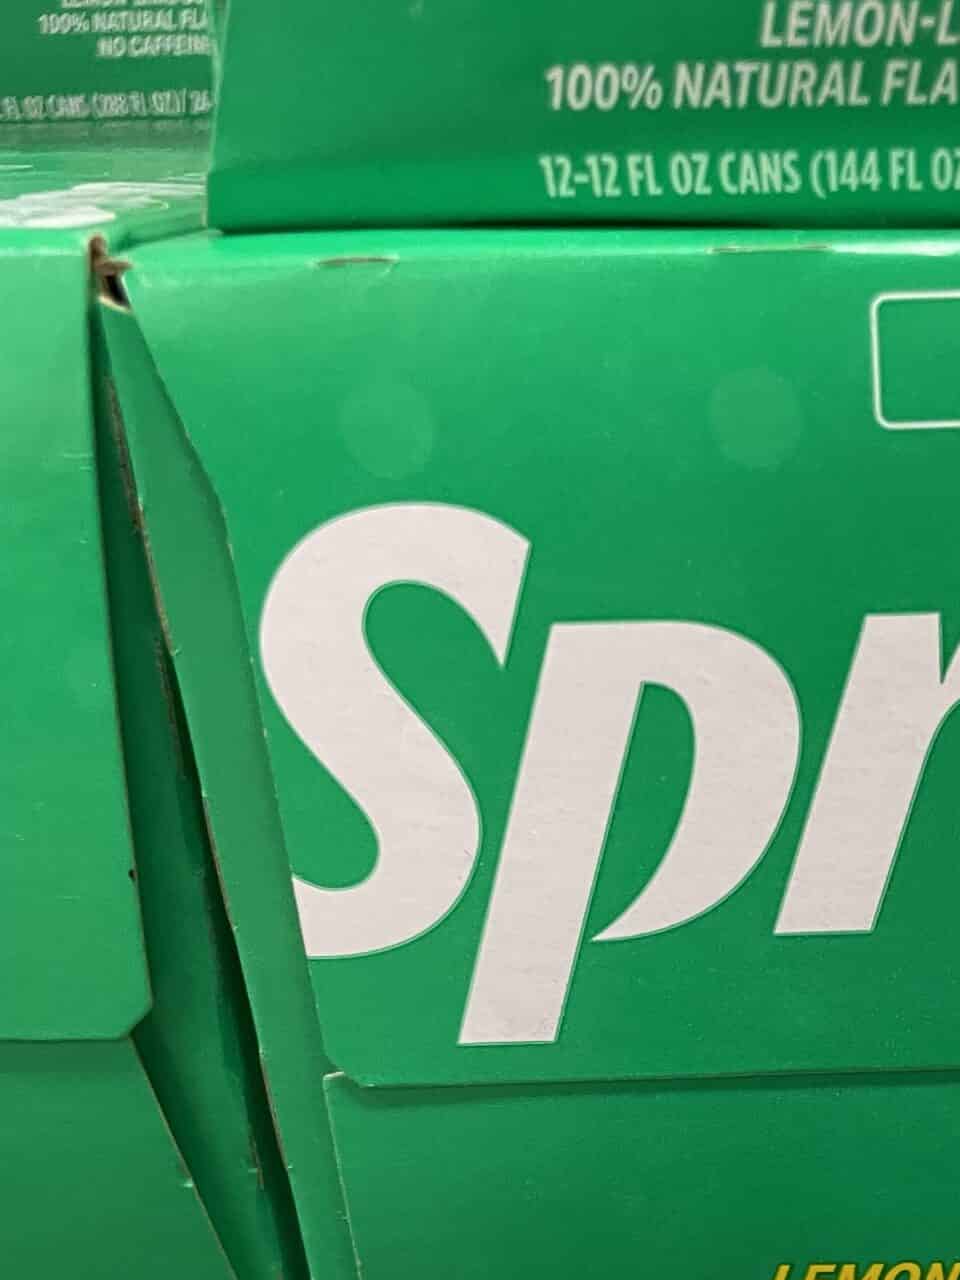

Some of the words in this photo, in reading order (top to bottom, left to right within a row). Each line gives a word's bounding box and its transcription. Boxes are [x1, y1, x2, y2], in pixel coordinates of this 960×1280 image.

[544, 62, 664, 111] 100%
[672, 60, 870, 109] NATURAL
[538, 153, 622, 198] 12-12
[626, 153, 663, 197] FL
[669, 152, 711, 196] OZ
[719, 150, 801, 195] CANS
[809, 147, 881, 199] (144
[888, 148, 923, 193] FL
